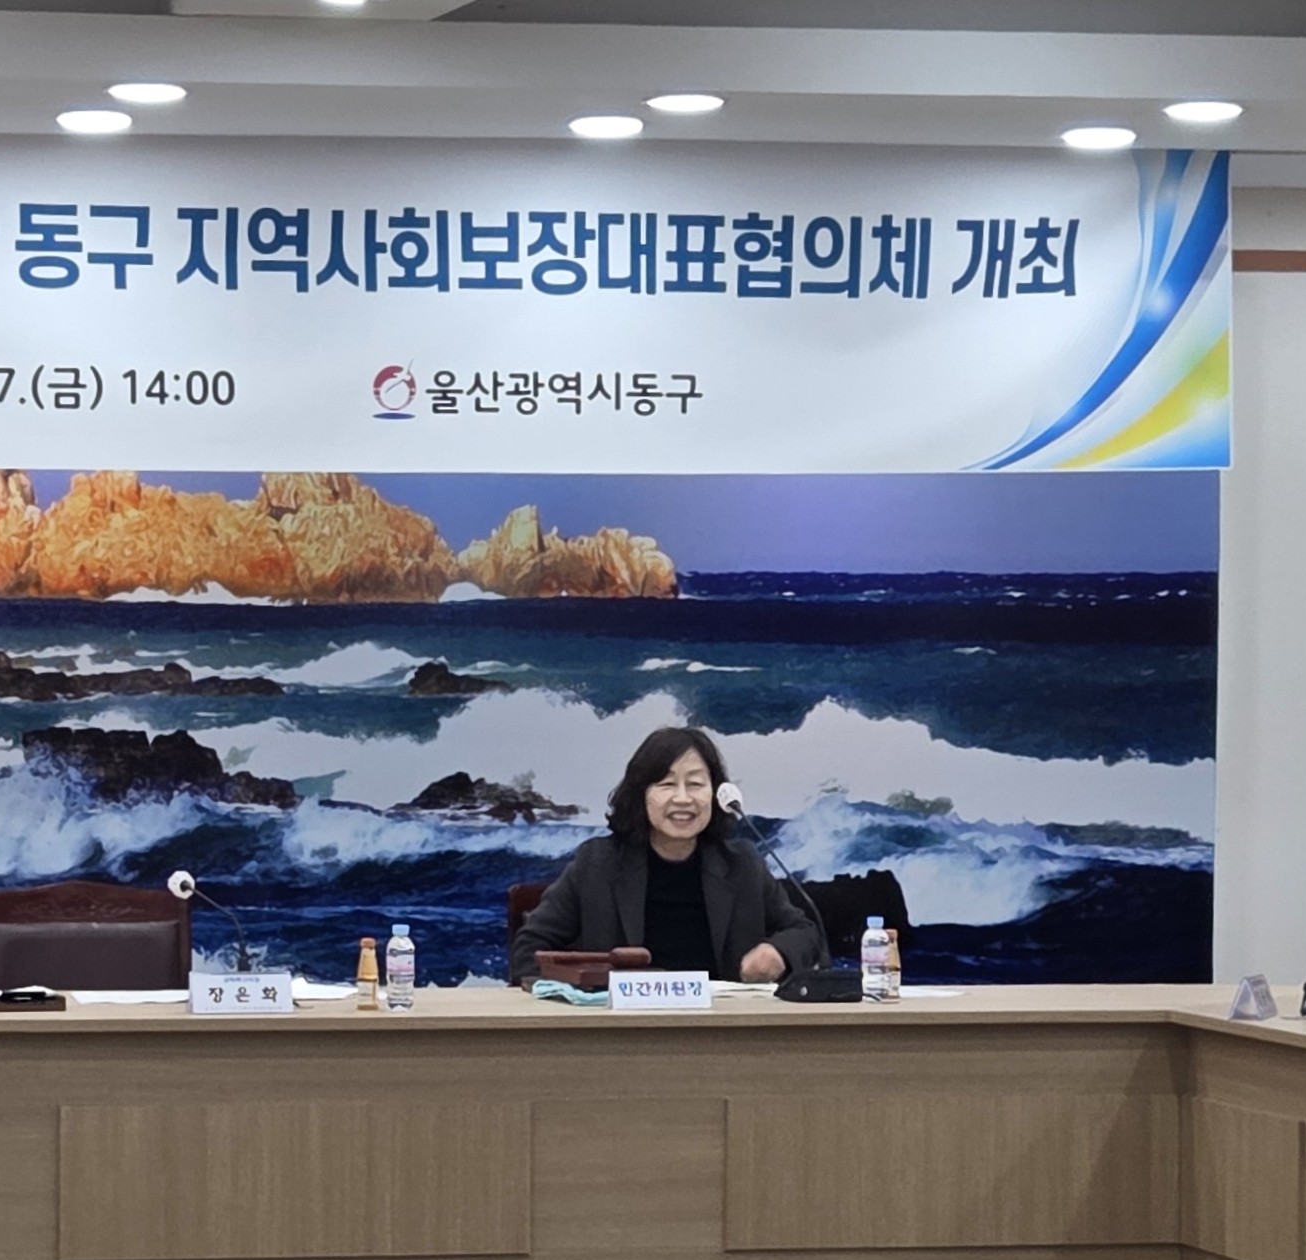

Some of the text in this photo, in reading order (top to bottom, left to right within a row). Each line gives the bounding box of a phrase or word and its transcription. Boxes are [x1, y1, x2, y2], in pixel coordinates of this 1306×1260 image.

[15, 202, 155, 291] 동구
[176, 206, 932, 300] 지역사회보장대표협의체
[951, 216, 1080, 300] 개최
[122, 368, 235, 406] 14:00
[425, 368, 704, 417] 울산광역시동구
